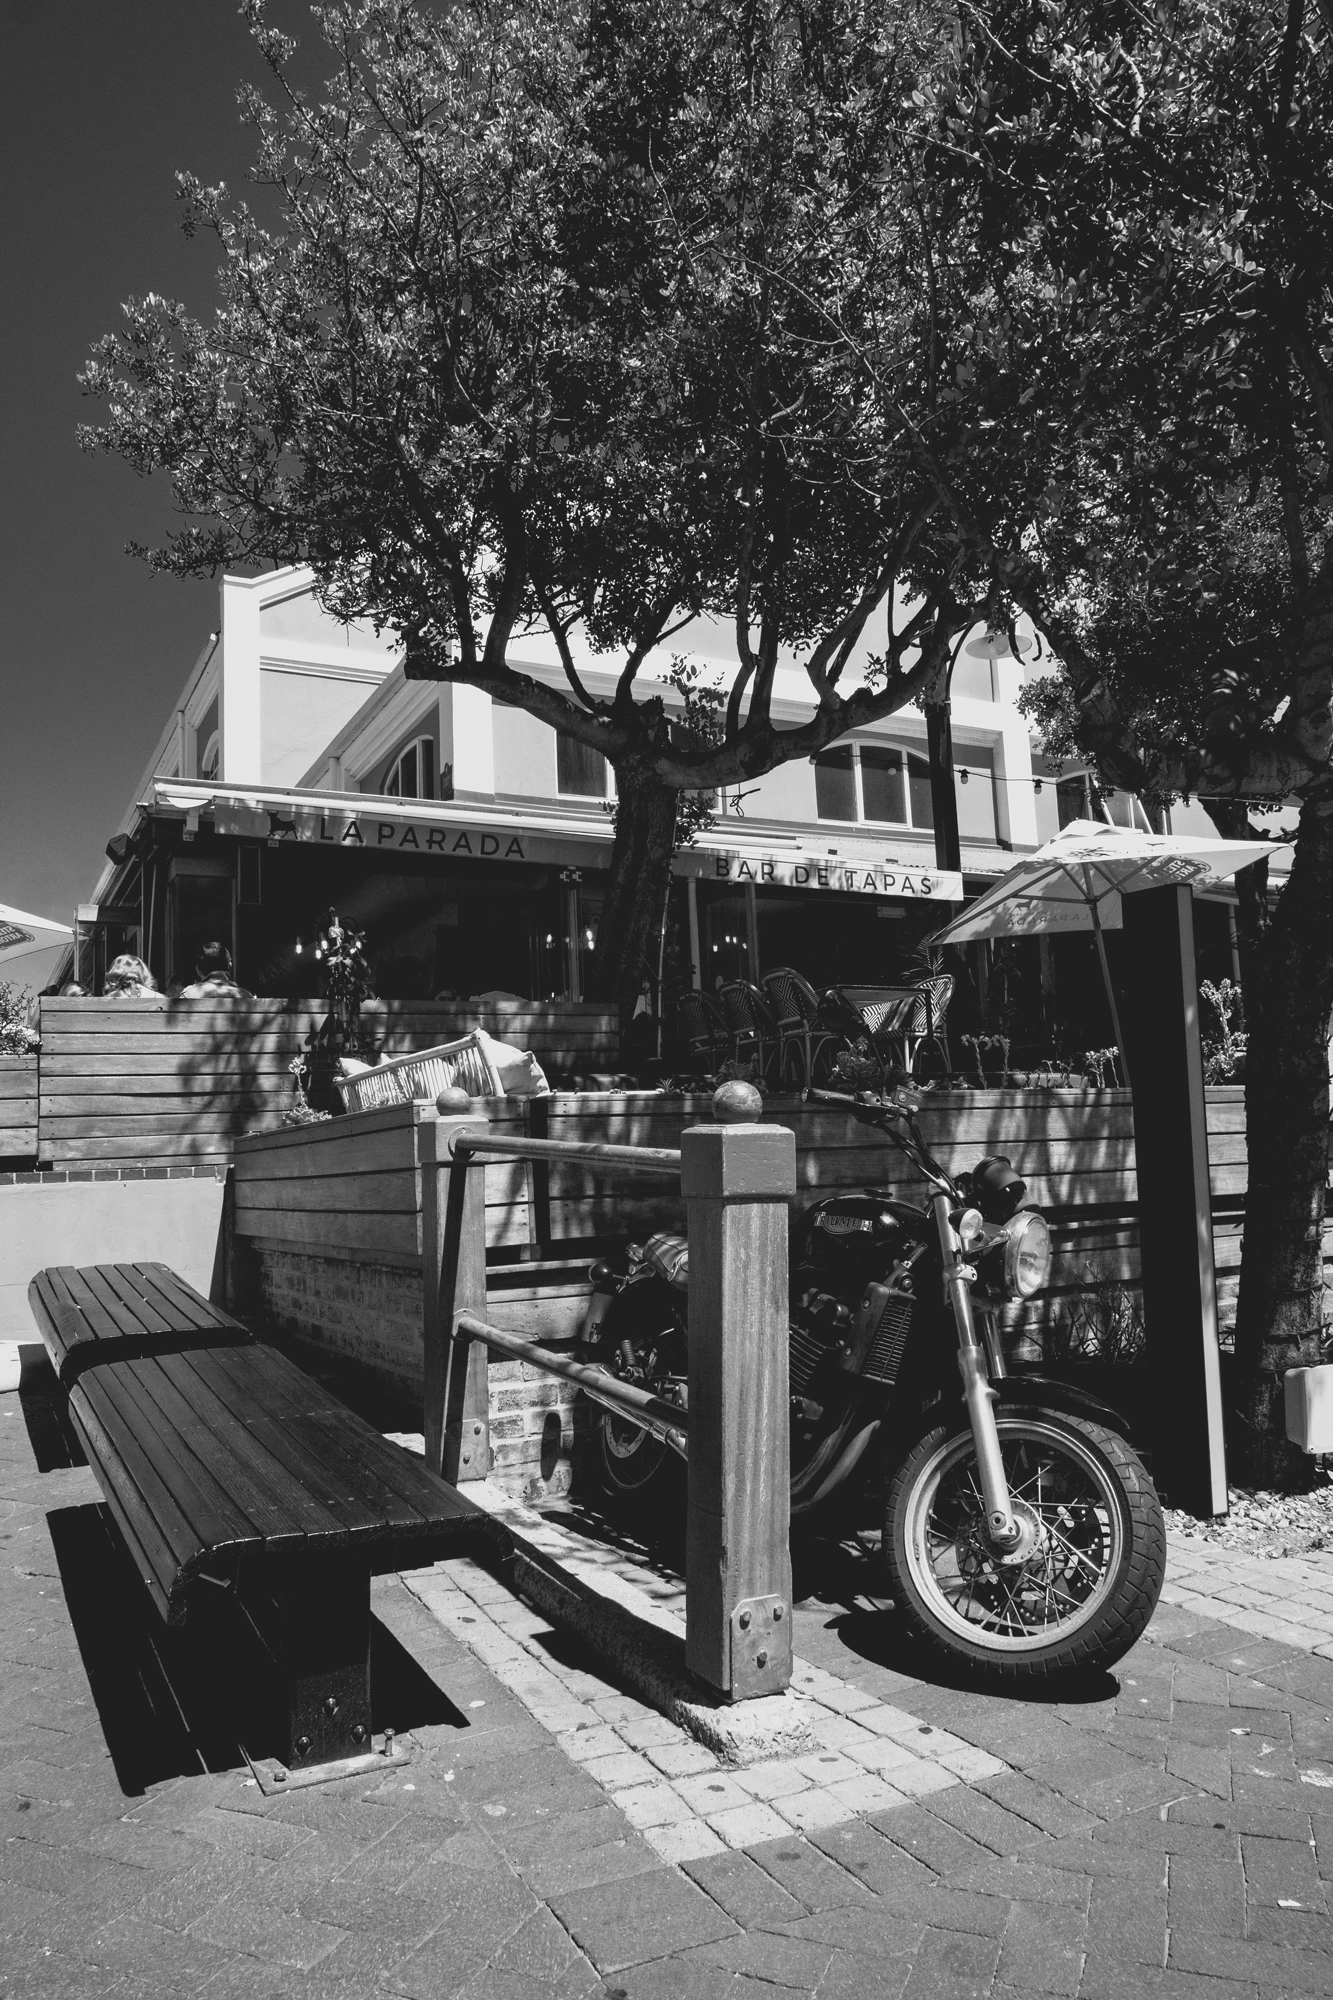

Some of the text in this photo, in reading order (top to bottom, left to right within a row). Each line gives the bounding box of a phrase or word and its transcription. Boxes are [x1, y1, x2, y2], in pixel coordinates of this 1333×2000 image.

[320, 817, 525, 859] LA PARADA
[715, 857, 932, 895] BAR DE TAPAS
[813, 1211, 873, 1233] TRIUMPH
